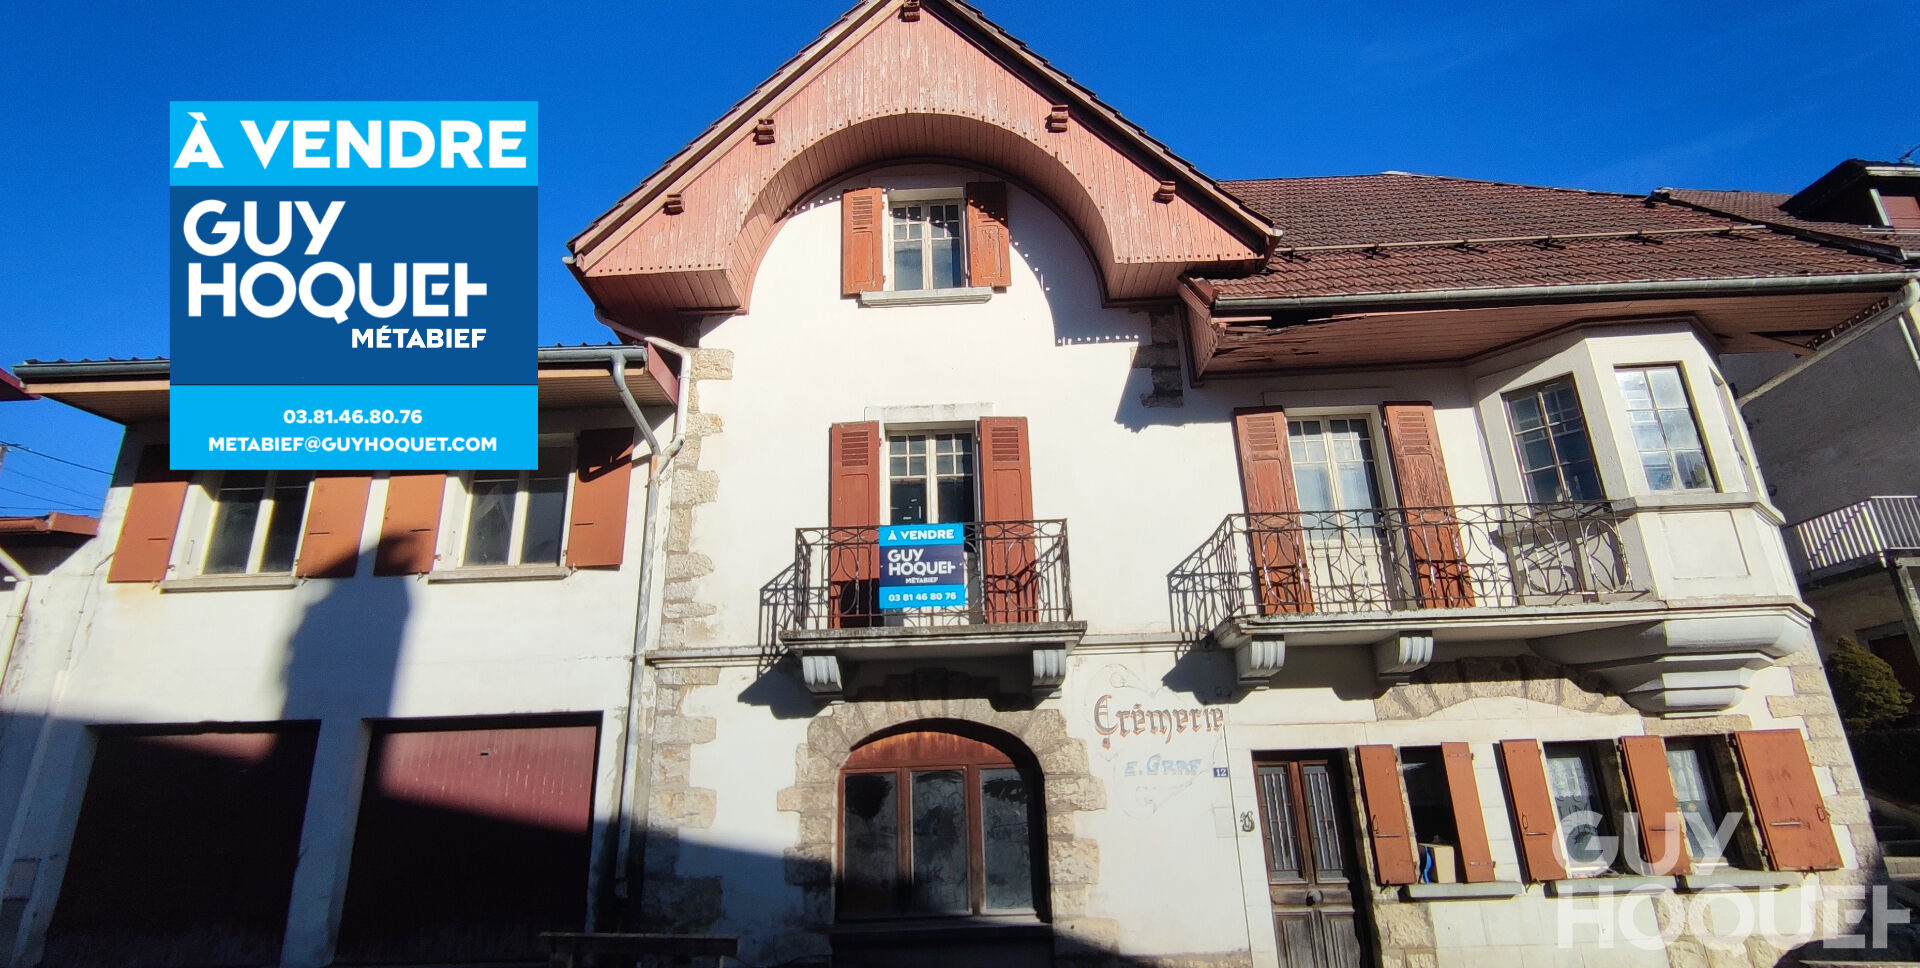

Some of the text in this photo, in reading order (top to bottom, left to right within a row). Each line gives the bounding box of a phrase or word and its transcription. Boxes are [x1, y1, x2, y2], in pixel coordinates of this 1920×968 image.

[888, 529, 954, 540] À VENDRE
[888, 548, 924, 562] GUY
[888, 561, 956, 576] HOQUET
[888, 594, 900, 602] 03
[930, 592, 942, 600] 80
[945, 592, 956, 600] 76
[1215, 769, 1227, 777] 12
